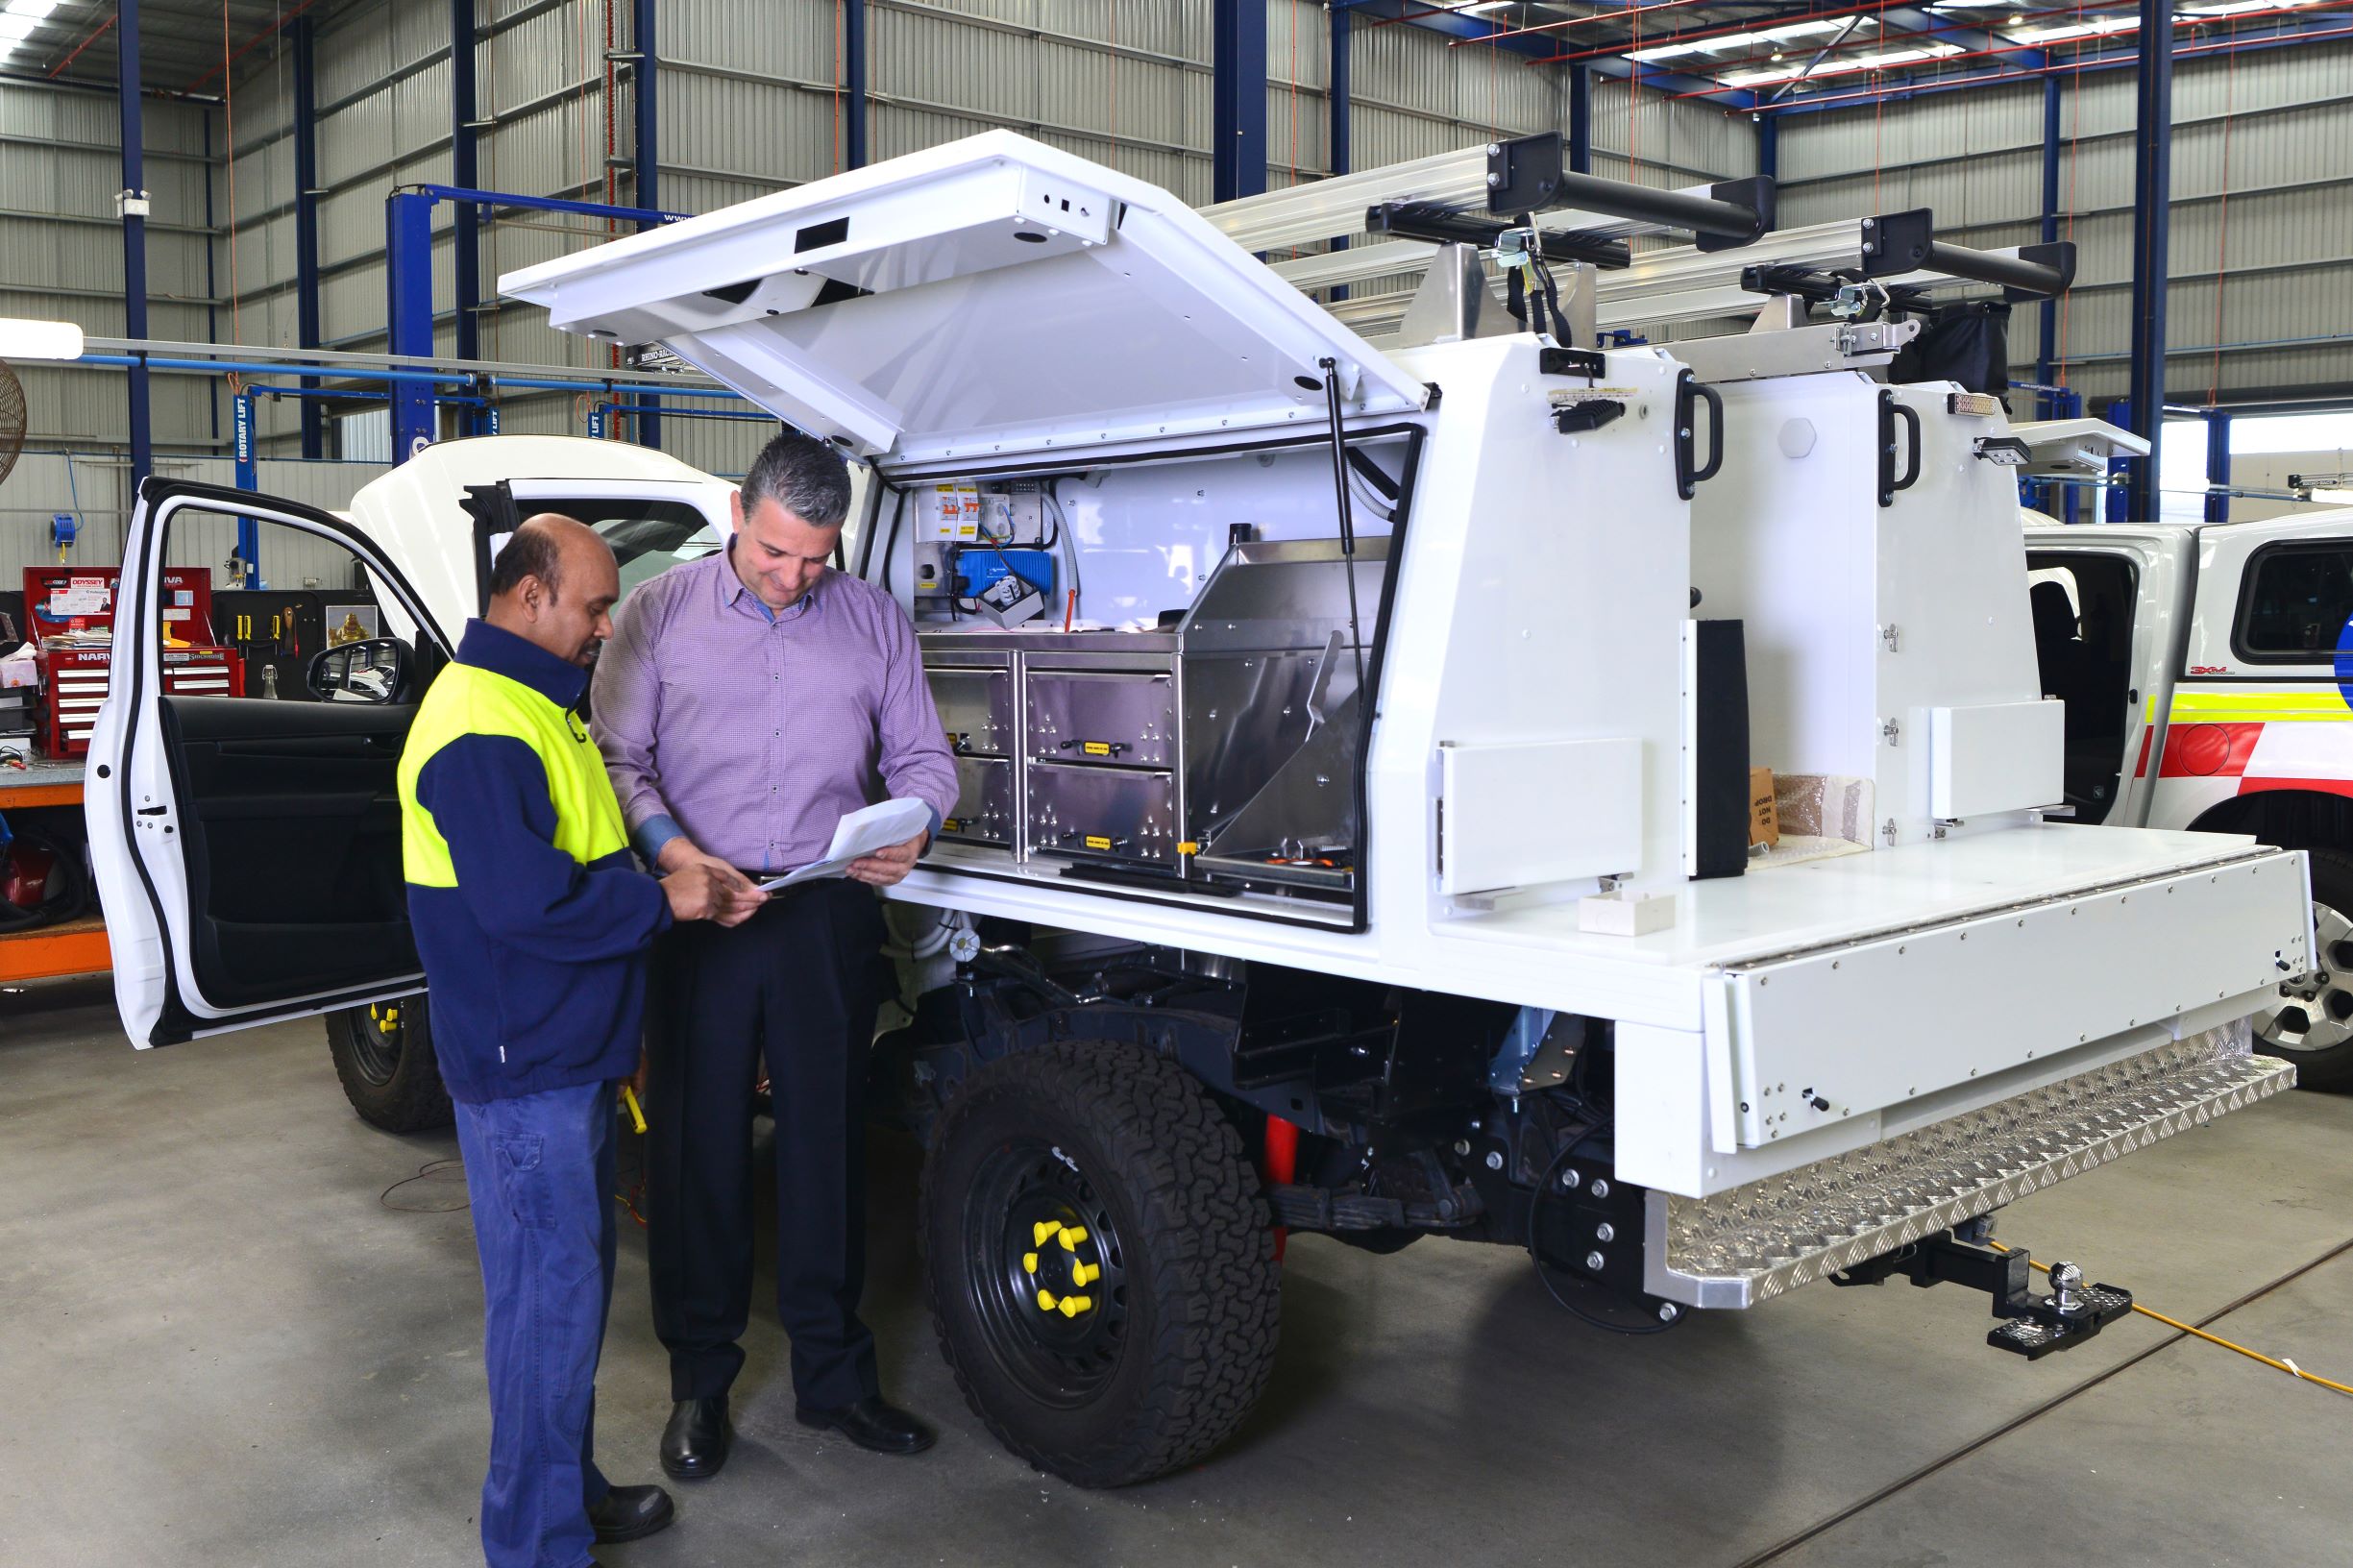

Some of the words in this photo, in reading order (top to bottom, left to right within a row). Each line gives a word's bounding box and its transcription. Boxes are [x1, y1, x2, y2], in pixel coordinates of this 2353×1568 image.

[237, 398, 246, 419] LIFT
[591, 415, 600, 434] LIFT
[238, 421, 248, 457] ROTARY
[1754, 796, 1772, 806] DROP
[1758, 806, 1771, 817] NOT
[1761, 817, 1771, 825] DO
